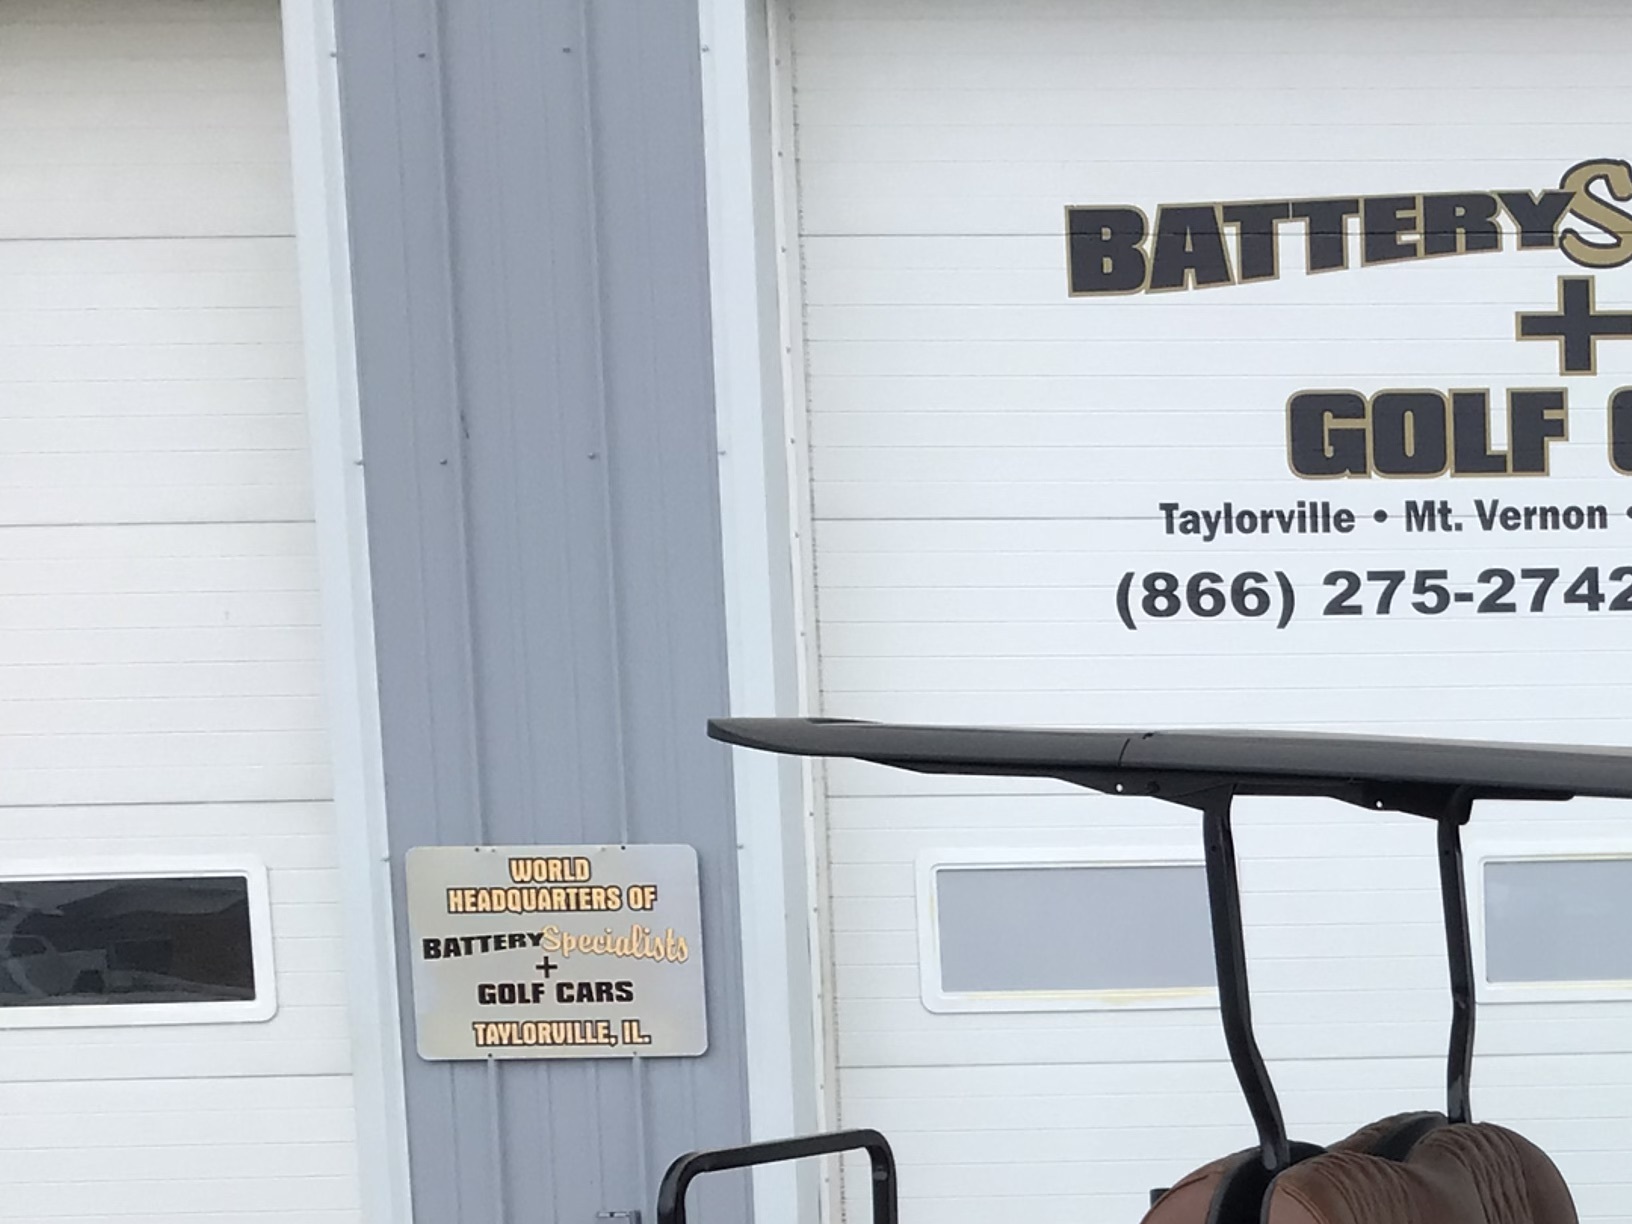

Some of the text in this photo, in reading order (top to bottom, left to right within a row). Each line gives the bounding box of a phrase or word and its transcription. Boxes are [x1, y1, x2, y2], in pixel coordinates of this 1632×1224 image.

[1065, 189, 1575, 297] BATTERY
[1287, 388, 1569, 478] GOLF
[1160, 501, 1356, 541] Taylorville
[1405, 503, 1465, 532] Mt.
[1475, 500, 1608, 532] Vernon
[1116, 571, 1295, 629] (866)
[509, 857, 590, 882] WORLD
[448, 885, 657, 914] HEADQUARTERS OF
[422, 924, 689, 963] BATTERY Specialists
[478, 981, 634, 1005] GOLF CARS
[473, 1020, 652, 1047] TAYLORVILLE, IL.
